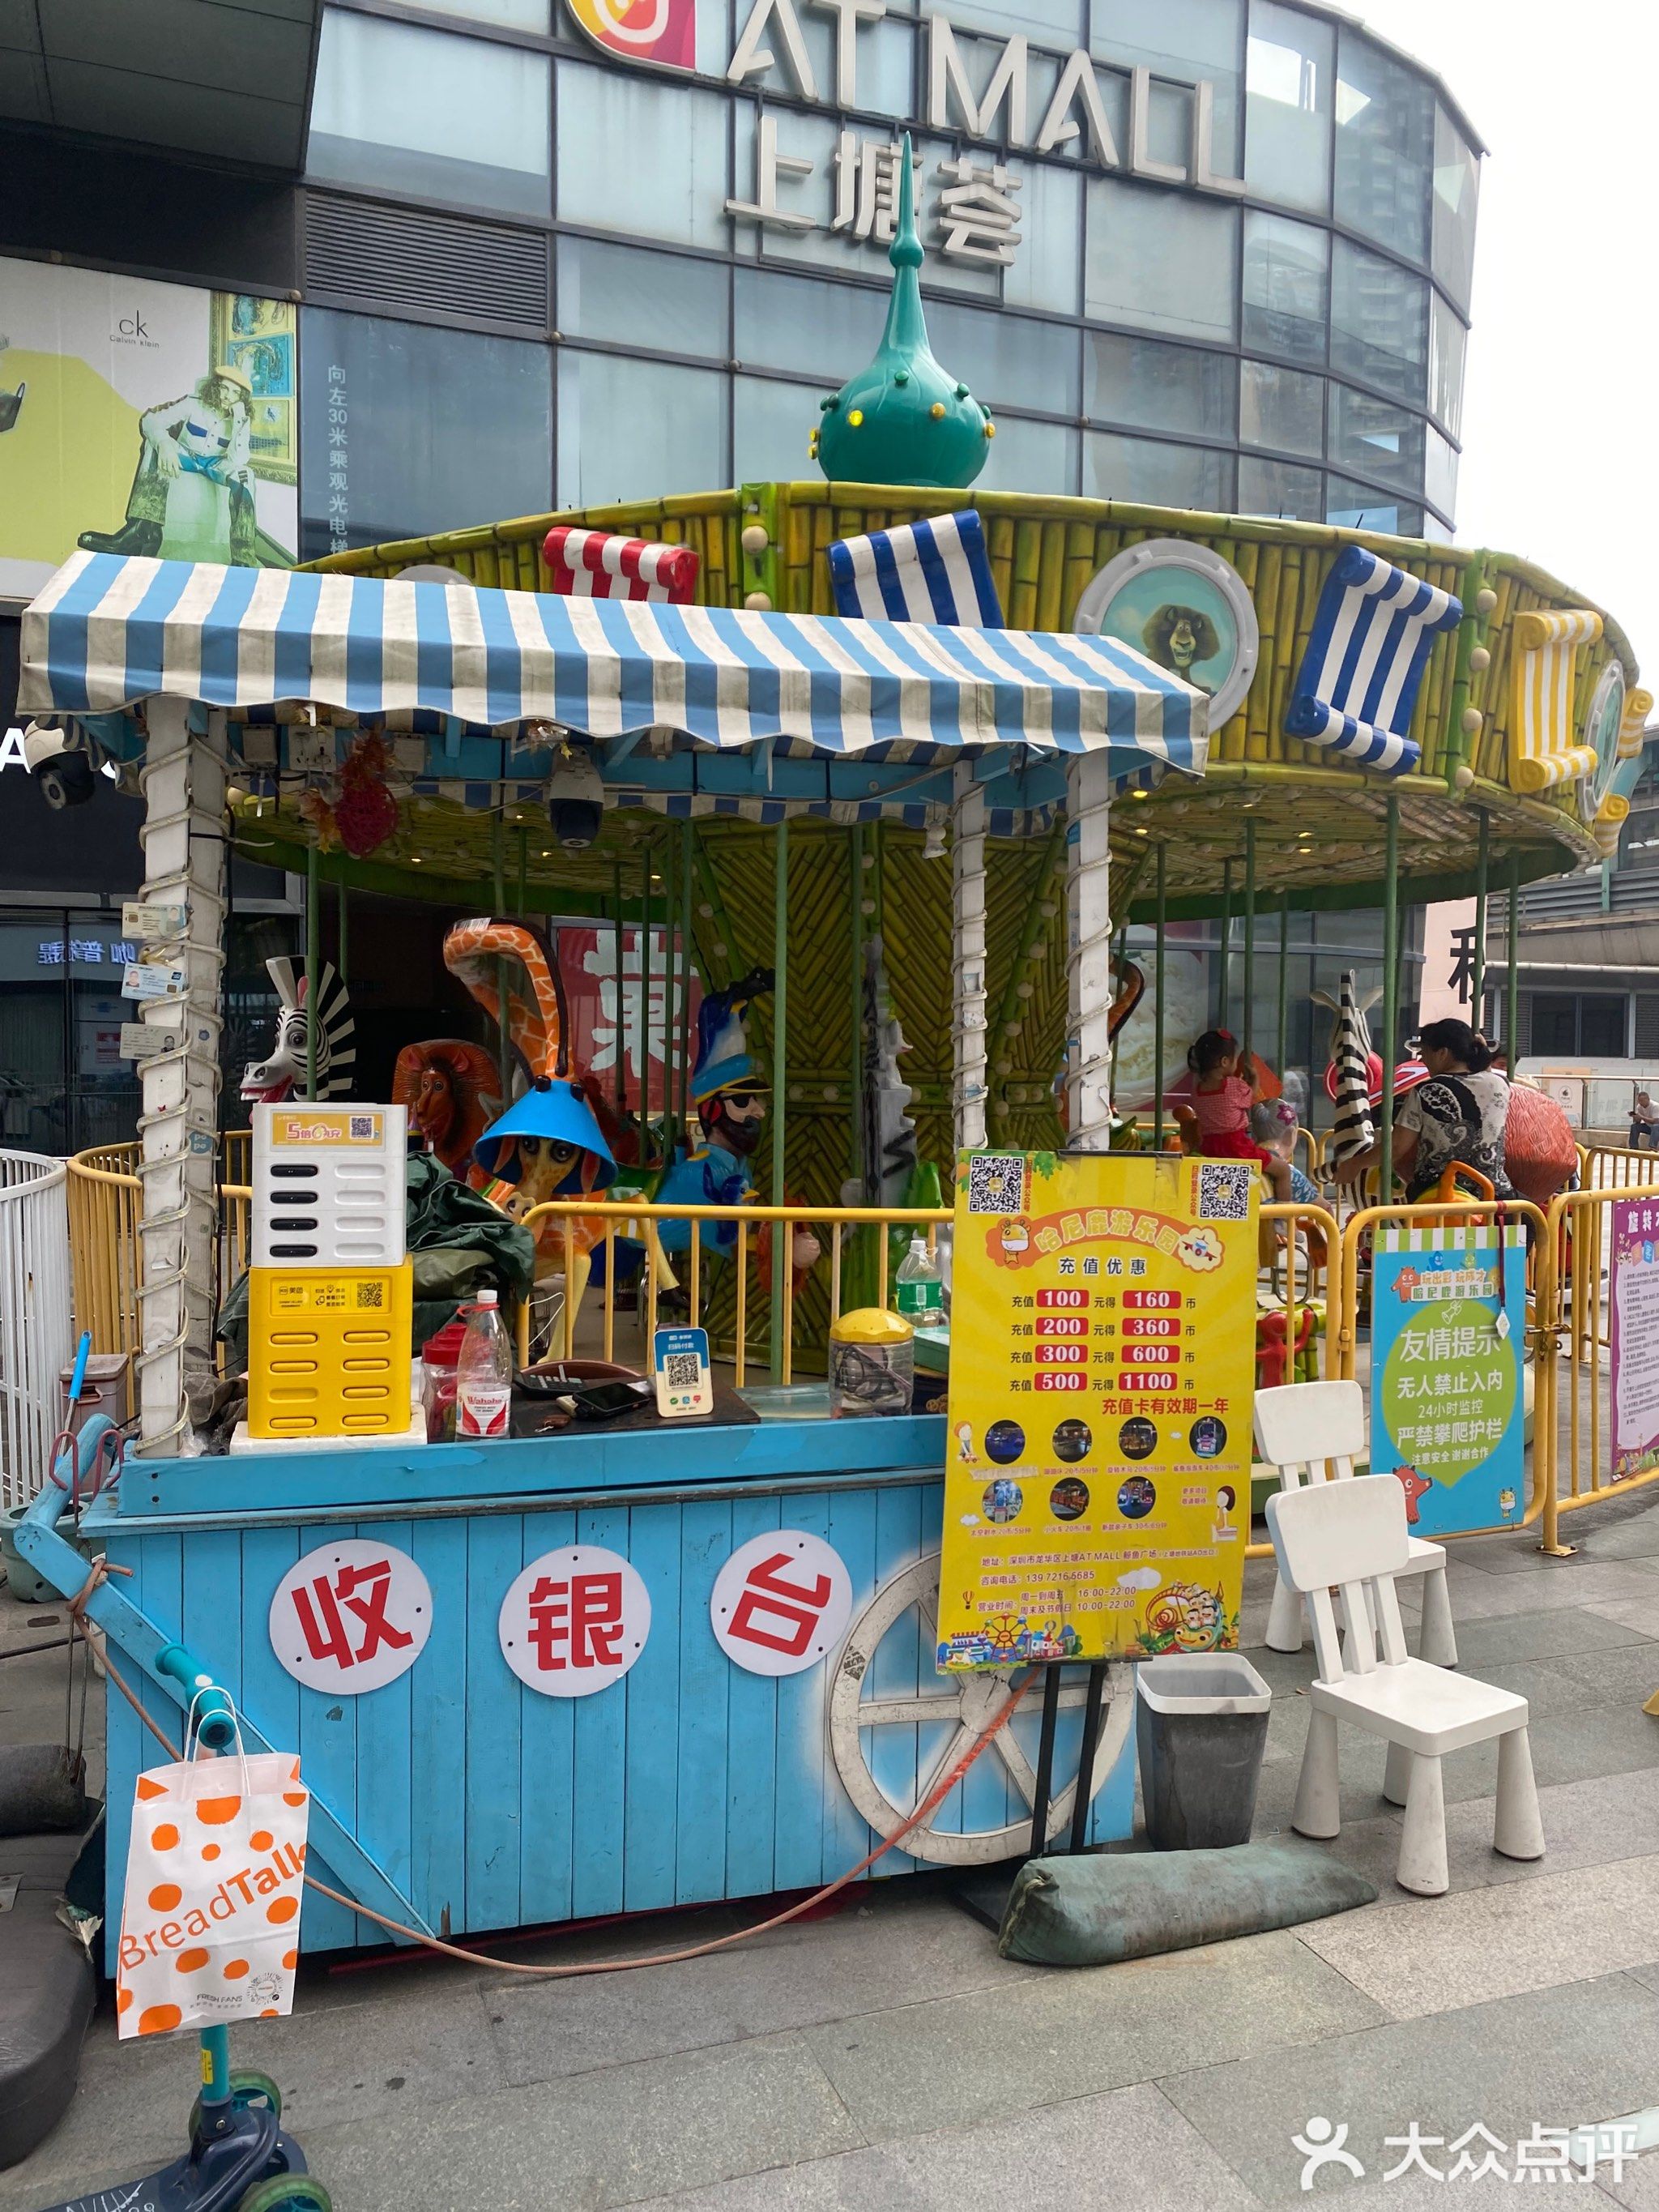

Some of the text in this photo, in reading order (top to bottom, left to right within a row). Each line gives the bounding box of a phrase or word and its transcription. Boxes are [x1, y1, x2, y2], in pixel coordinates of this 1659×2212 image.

[927, 14, 1247, 199] MALL
[119, 310, 149, 338] ck
[1034, 1209, 1180, 1255] 哈尼鹿游乐园
[1060, 1258, 1146, 1275] 充值优惠
[1013, 1291, 1196, 1309] 充值 100 元得 160 币
[1011, 1319, 1196, 1337] 充值 200 元得 360 币
[1400, 1326, 1501, 1363] 友情提示
[1010, 1347, 1195, 1364] 充值 300 元得 600 币
[1009, 1374, 1194, 1391] 充值 500 元得 1100 币
[1397, 1369, 1503, 1399] 无人禁止入内
[467, 1395, 502, 1405] Wahaha
[1102, 1398, 1229, 1415] 充值卡有效期一年
[1418, 1399, 1483, 1419] 24小时监控
[1397, 1417, 1502, 1450] 严禁攀爬护栏
[1412, 1450, 1450, 1466] 注意安全
[1094, 1552, 1120, 1561] MALL
[1026, 1574, 1043, 1582] 139
[1078, 1586, 1137, 1598] 16:00-22:00
[1077, 1599, 1135, 1611] 10:00-22:00
[118, 1843, 306, 1971] BreadTalk
